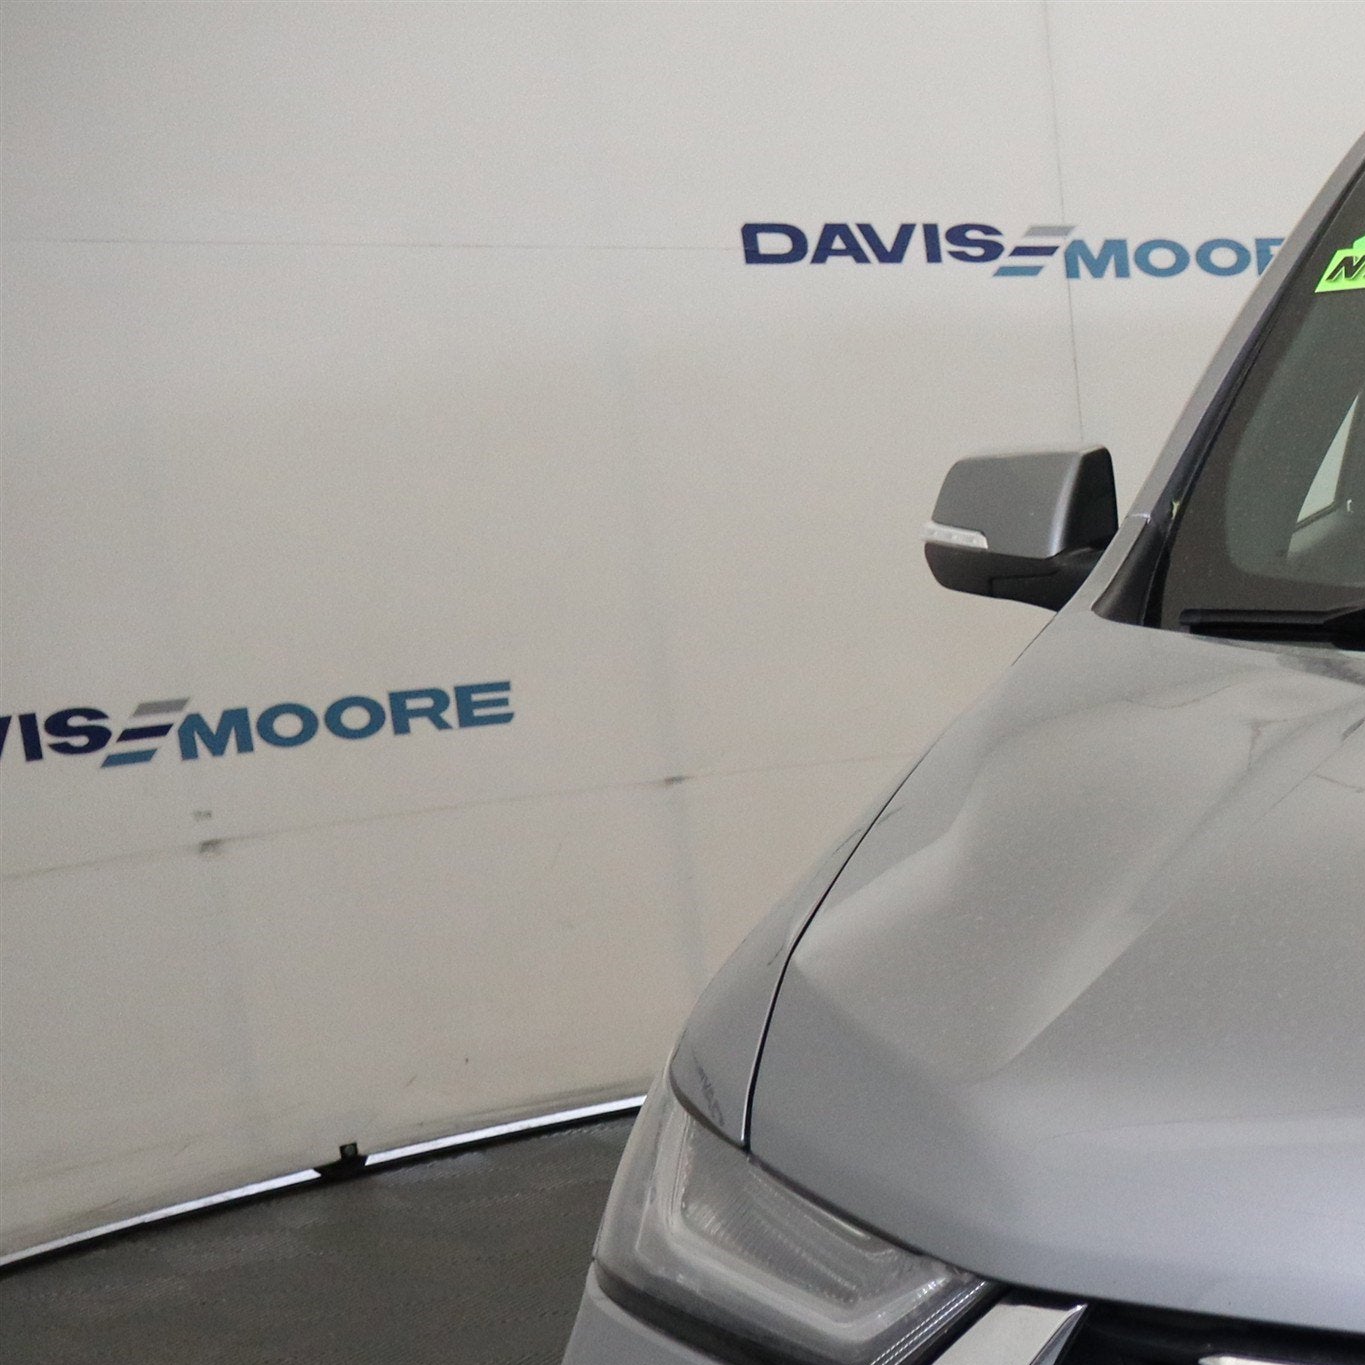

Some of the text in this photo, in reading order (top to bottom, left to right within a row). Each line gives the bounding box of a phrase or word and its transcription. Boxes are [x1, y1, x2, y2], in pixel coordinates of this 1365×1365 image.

[741, 223, 1006, 265] DAVIS
[0, 681, 516, 763] IS MOORE
